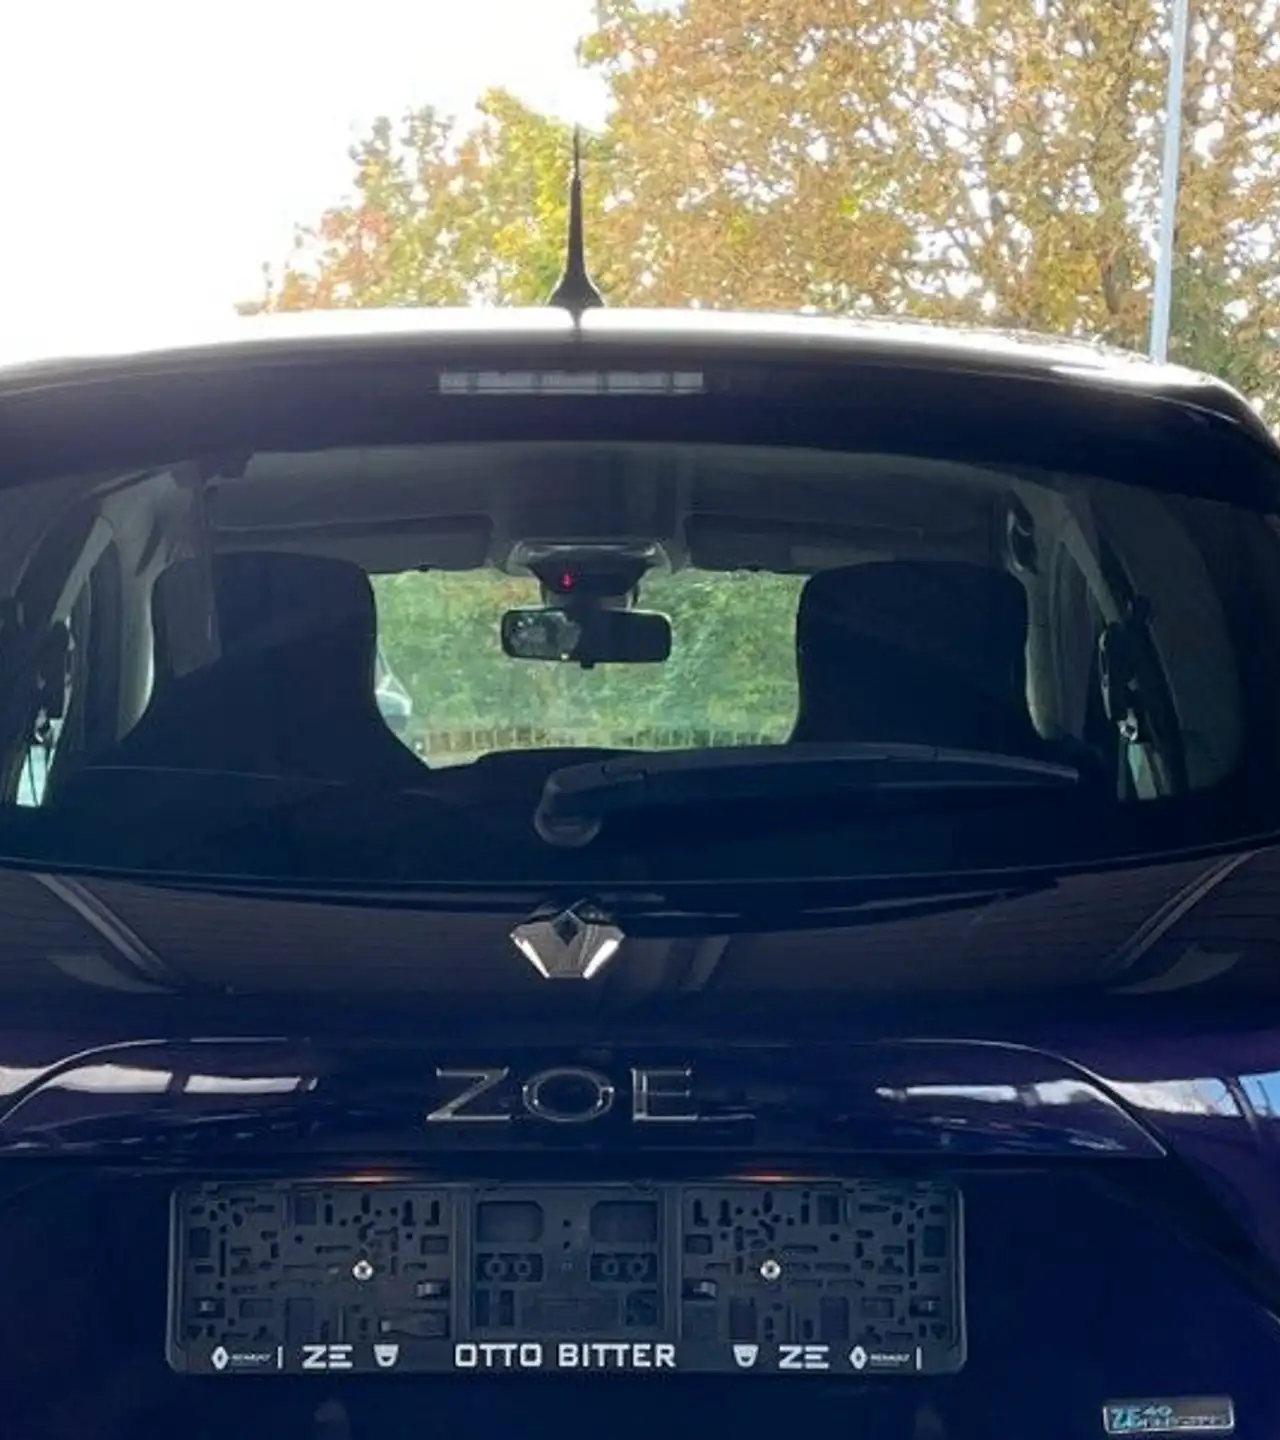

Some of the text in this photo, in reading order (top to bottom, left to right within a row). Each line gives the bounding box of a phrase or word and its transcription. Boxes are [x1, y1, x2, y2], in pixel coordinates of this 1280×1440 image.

[426, 1066, 698, 1122] ZOE
[302, 1344, 353, 1369] ZE
[455, 1343, 676, 1367] OTTO BITTER
[778, 1344, 830, 1370] ZE
